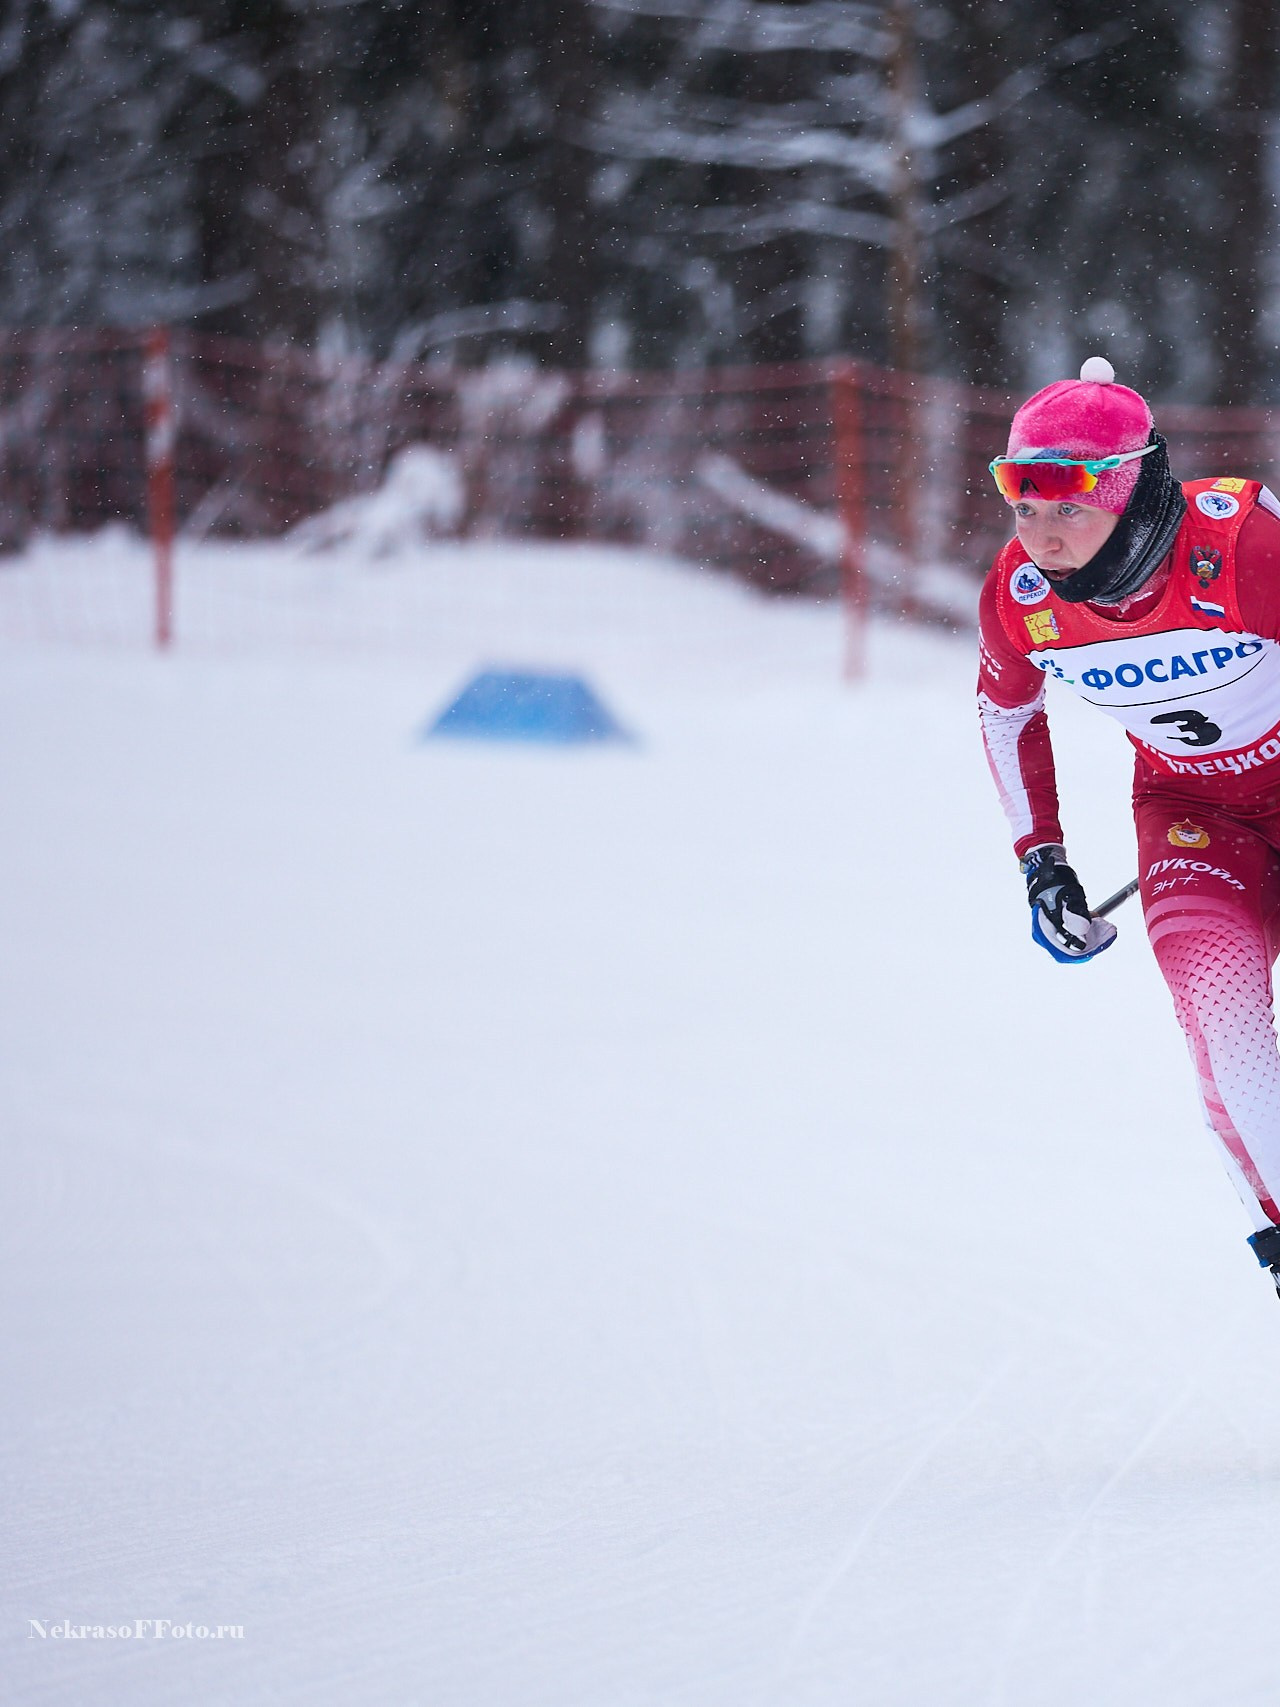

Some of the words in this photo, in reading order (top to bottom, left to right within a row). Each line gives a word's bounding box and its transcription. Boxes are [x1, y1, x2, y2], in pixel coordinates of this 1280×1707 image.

[1018, 589, 1047, 602] ПЕРЕКОП
[1081, 642, 1263, 690] ФОСАГРО
[1150, 710, 1222, 747] 3
[1146, 858, 1246, 890] ЛУКОЙЛ
